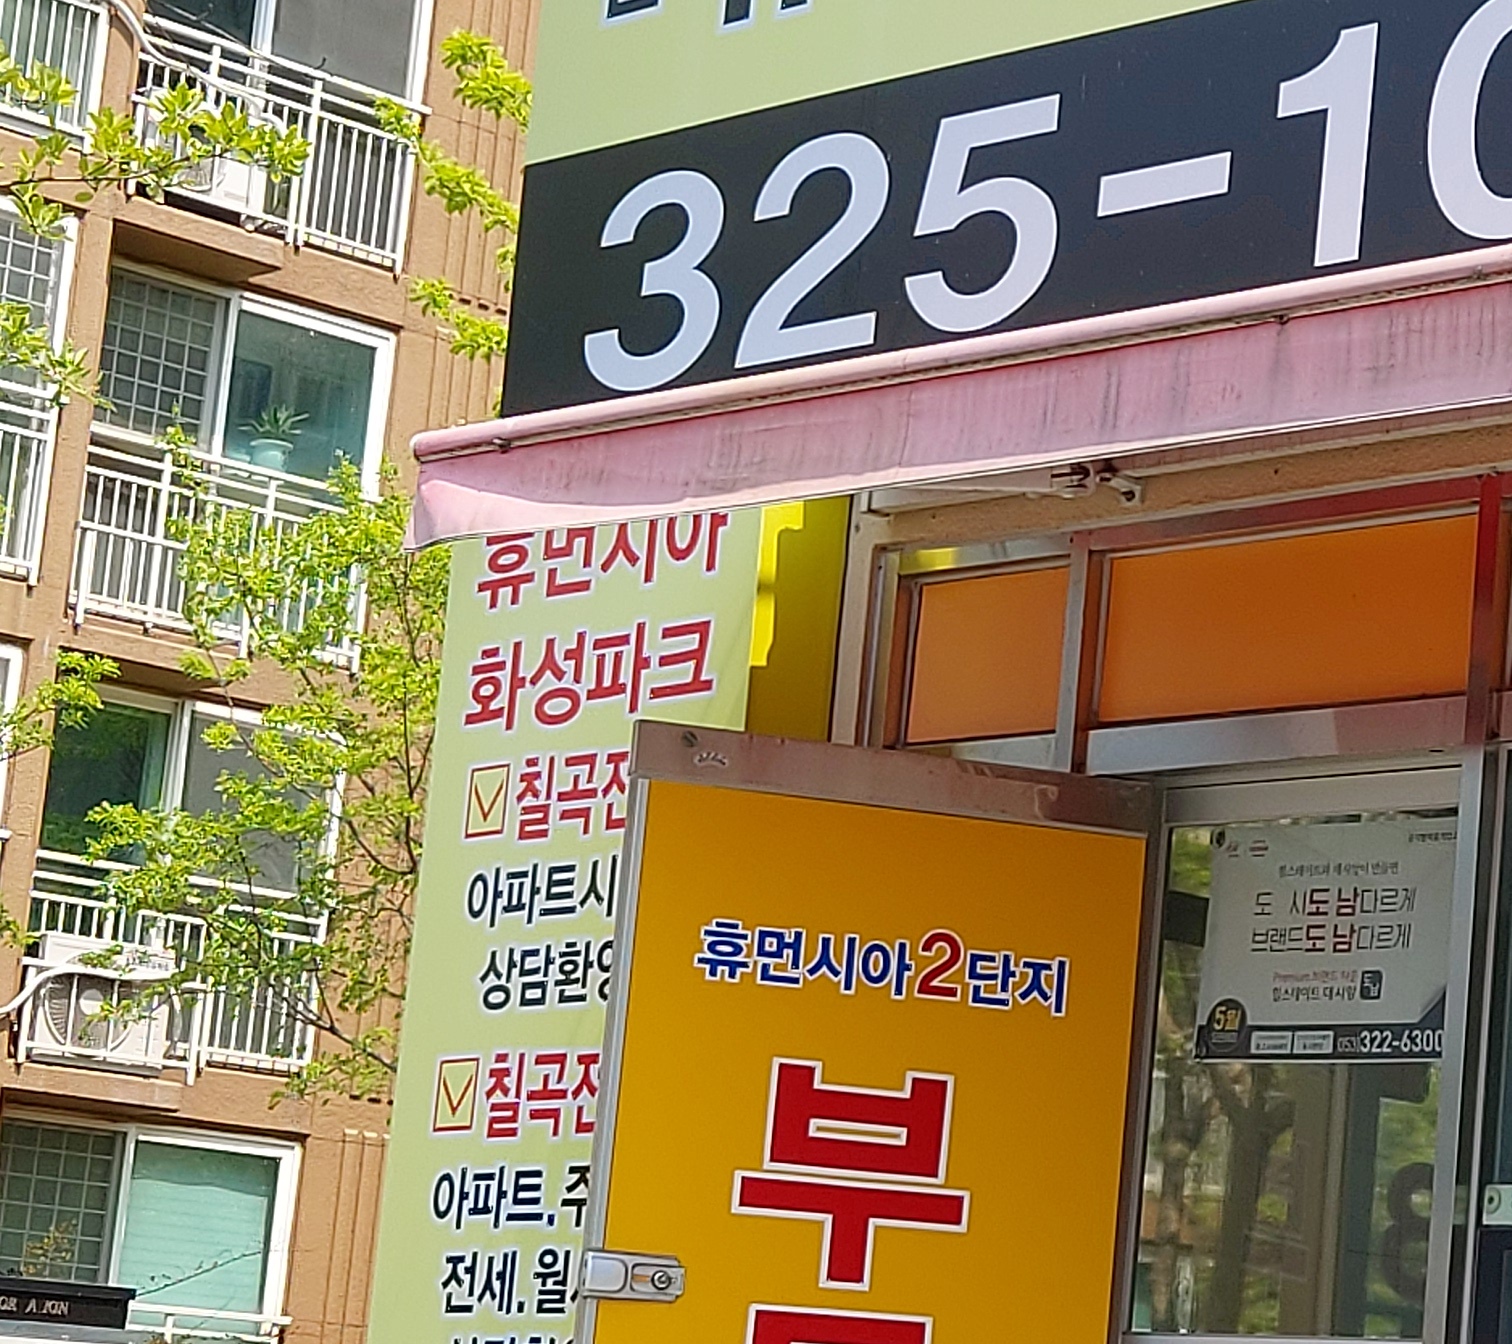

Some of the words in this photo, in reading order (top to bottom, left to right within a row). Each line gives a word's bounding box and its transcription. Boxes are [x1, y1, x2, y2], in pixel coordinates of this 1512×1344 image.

[476, 512, 729, 610] 휴먼시아
[463, 619, 714, 731] 화성파크
[694, 917, 1071, 1018] 휴먼시아2단지
